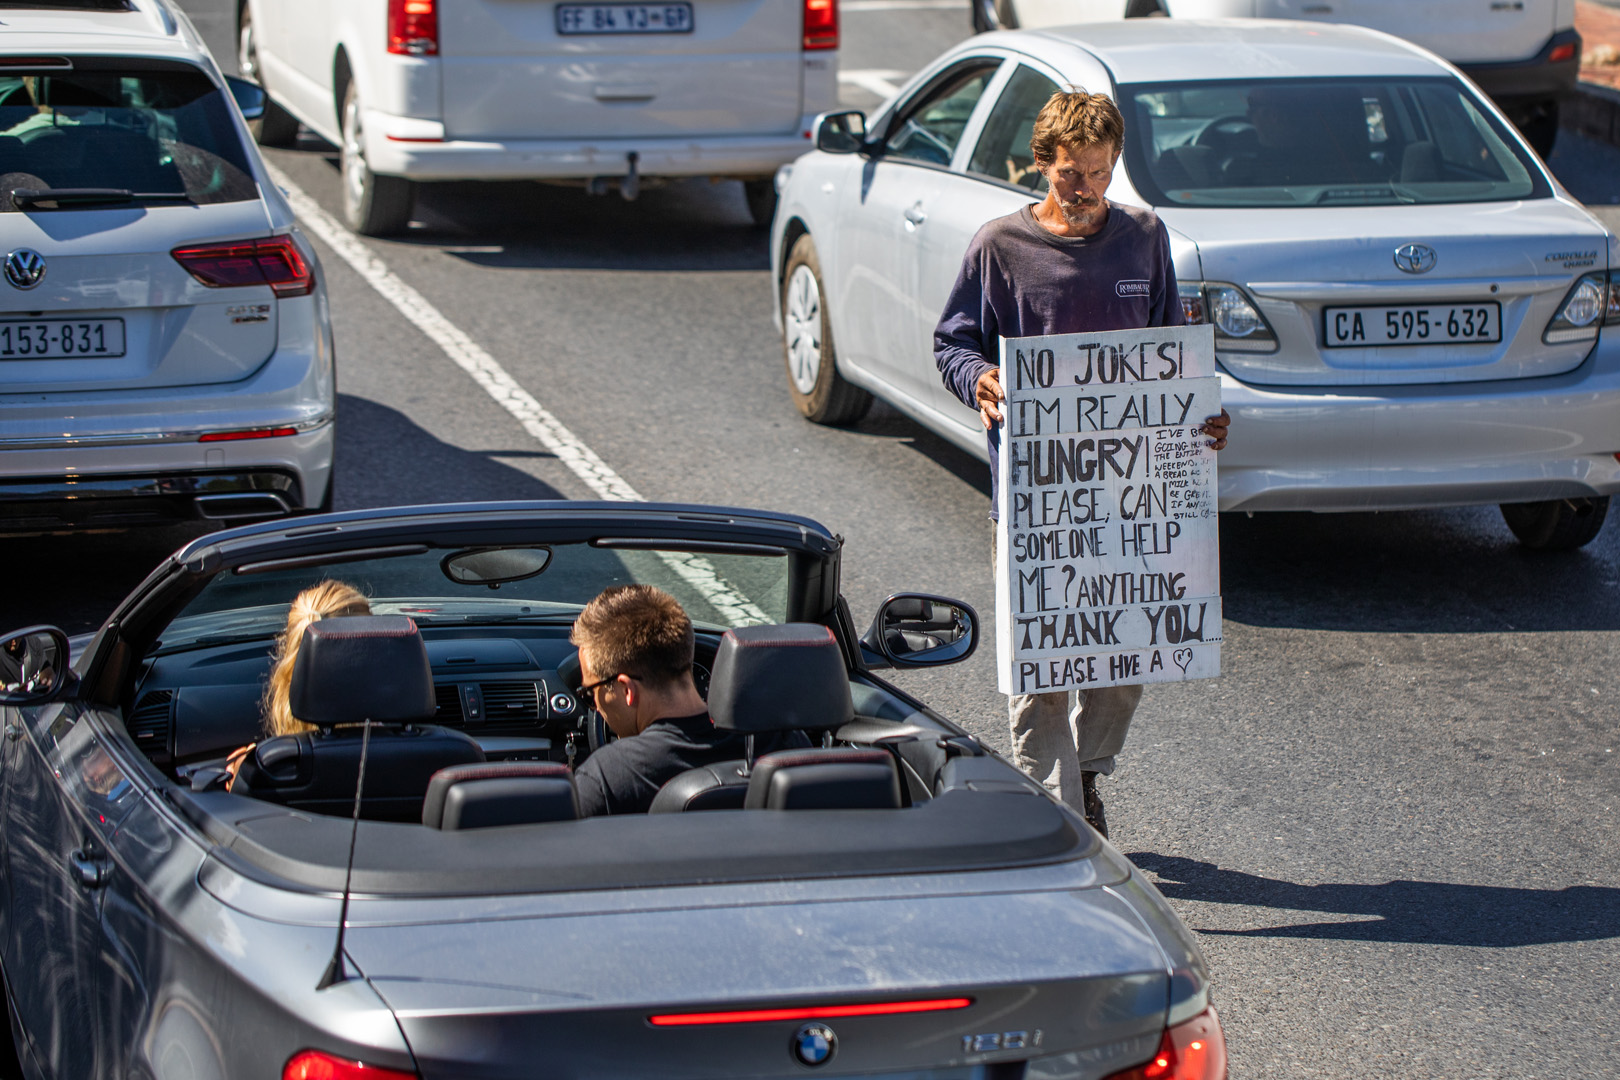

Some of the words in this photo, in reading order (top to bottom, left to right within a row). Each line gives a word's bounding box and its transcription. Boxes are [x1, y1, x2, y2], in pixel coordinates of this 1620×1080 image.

[2, 324, 107, 355] 153-831
[1335, 312, 1365, 341] CA
[1386, 308, 1490, 339] 595-632
[1016, 348, 1055, 390] NO
[1074, 341, 1183, 385] JOKES!
[1012, 397, 1061, 437] I'M
[1077, 392, 1195, 433] REALLY
[1155, 429, 1184, 440] I'VE
[1155, 441, 1188, 453] GOING
[1012, 434, 1149, 487] HUNGRY!
[1154, 452, 1170, 462] THE
[1154, 471, 1161, 479] A
[1163, 469, 1188, 479] BREAD
[1169, 480, 1189, 488] MILK
[1120, 482, 1167, 521] CAN
[1170, 490, 1179, 499] BE
[1171, 500, 1183, 509] IF
[1173, 511, 1199, 519] STILL
[1014, 526, 1107, 563] SOMEONE
[1121, 521, 1181, 558] HELP
[1076, 572, 1186, 608] ANYTHING
[1017, 609, 1124, 650] THANK
[1020, 656, 1099, 693] PLEASE
[1150, 650, 1164, 673] A
